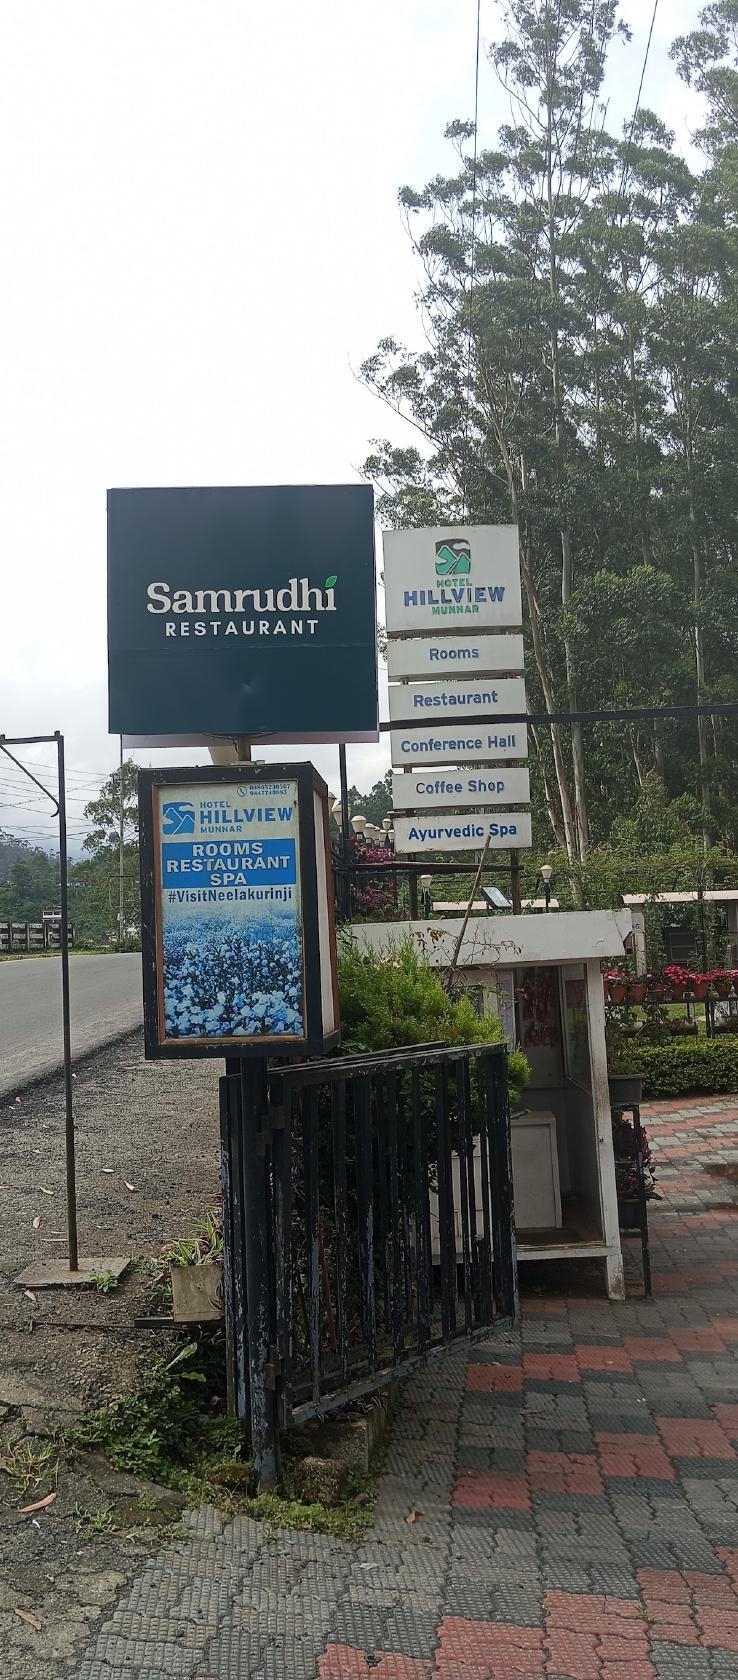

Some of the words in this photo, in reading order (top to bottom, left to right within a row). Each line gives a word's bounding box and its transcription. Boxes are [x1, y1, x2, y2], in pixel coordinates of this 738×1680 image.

[437, 578, 472, 587] HOTEL
[146, 575, 337, 613] Samrudhi
[404, 587, 505, 606] HILLVIEW
[432, 605, 480, 615] MUNNAR
[165, 619, 320, 637] RESTAURANT
[429, 648, 480, 660] Rooms
[413, 690, 498, 707] Restaurant
[401, 738, 482, 752] Conference
[488, 735, 515, 748] Hall
[416, 781, 462, 794] Coffee
[468, 780, 505, 793] Shop
[200, 807, 293, 824] HILLVIEW
[200, 825, 243, 834] MUNNAR
[409, 826, 484, 841] Ayurvedic
[489, 824, 517, 837] Spa
[192, 842, 264, 857] ROOMS
[166, 856, 290, 873] RESTAURANT
[210, 873, 248, 886] SPA
[168, 888, 291, 903] #VisitNeelakurinji
